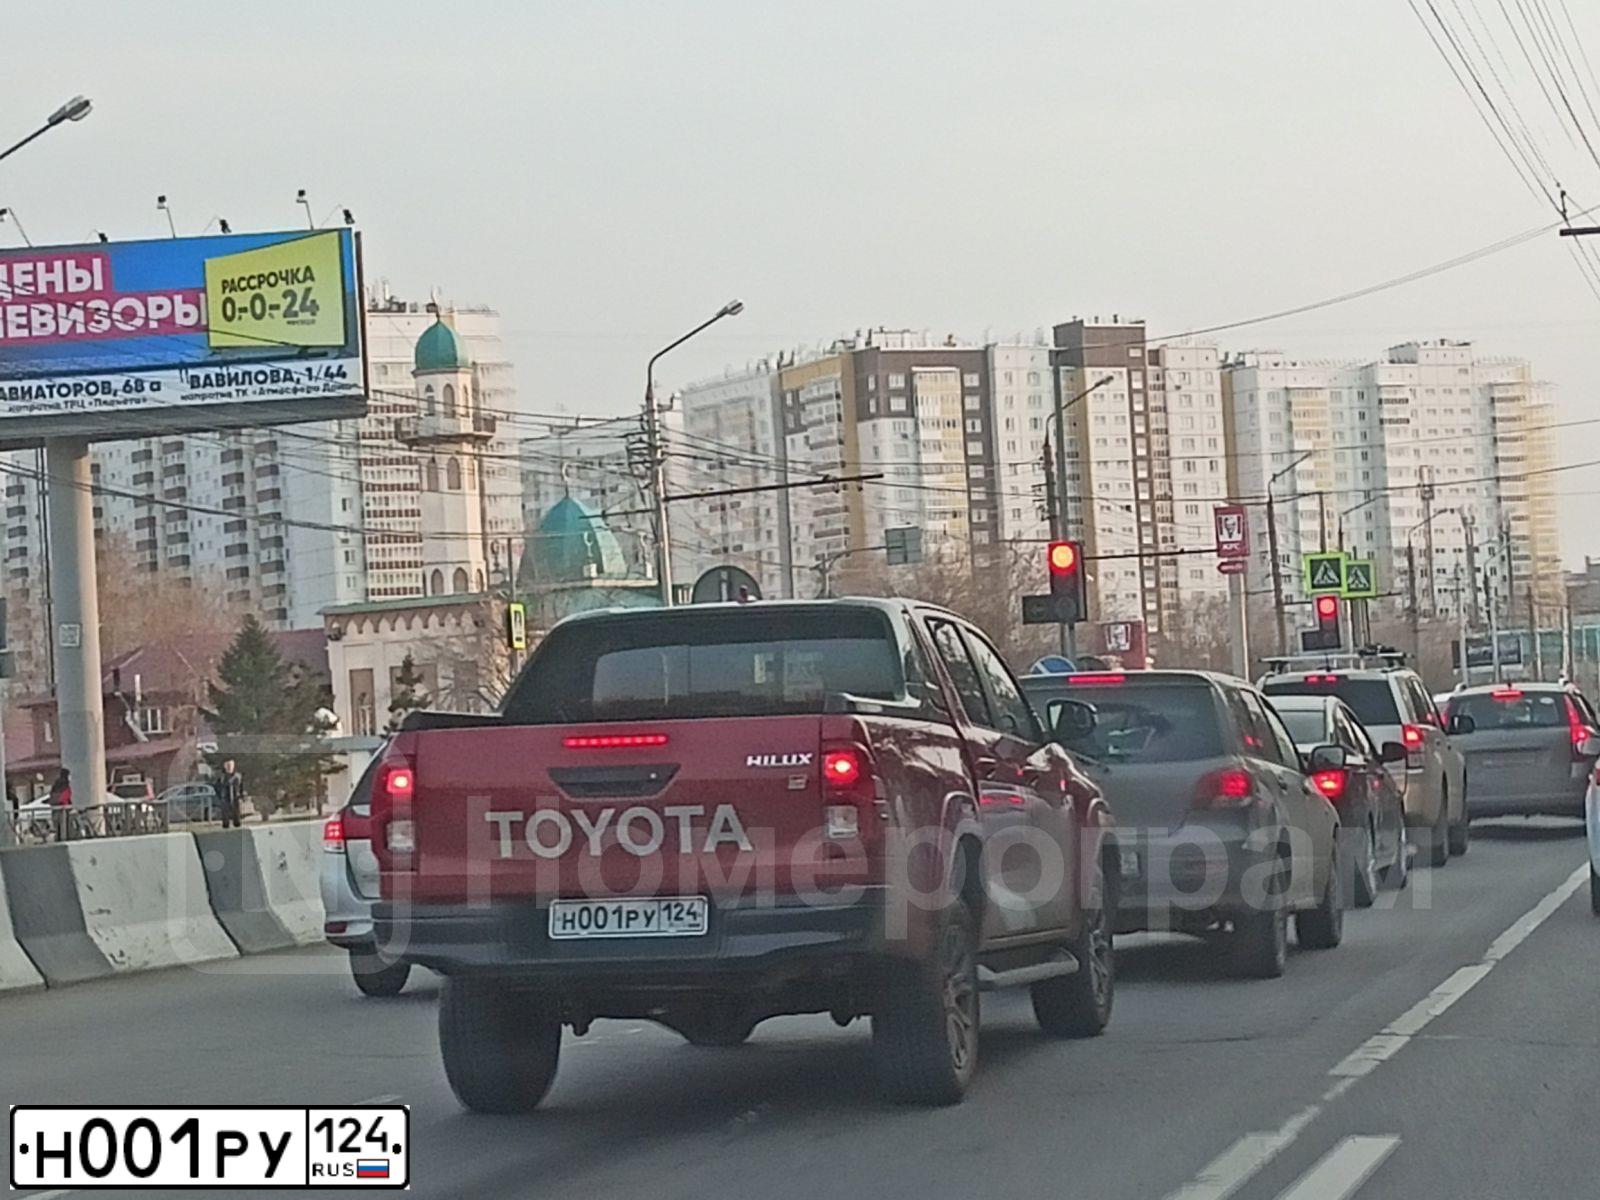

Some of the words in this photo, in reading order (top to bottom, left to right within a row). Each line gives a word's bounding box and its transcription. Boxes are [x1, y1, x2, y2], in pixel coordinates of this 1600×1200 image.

[221, 265, 315, 295] РАССРОЧКА
[0, 293, 206, 338] ЕВИЗОРЫ
[190, 368, 300, 390] ВАВИЛОВА,
[746, 753, 813, 767] HILUX
[484, 804, 754, 860] TOYOTA
[561, 904, 656, 931] Н001РУ
[662, 902, 698, 922] 124
